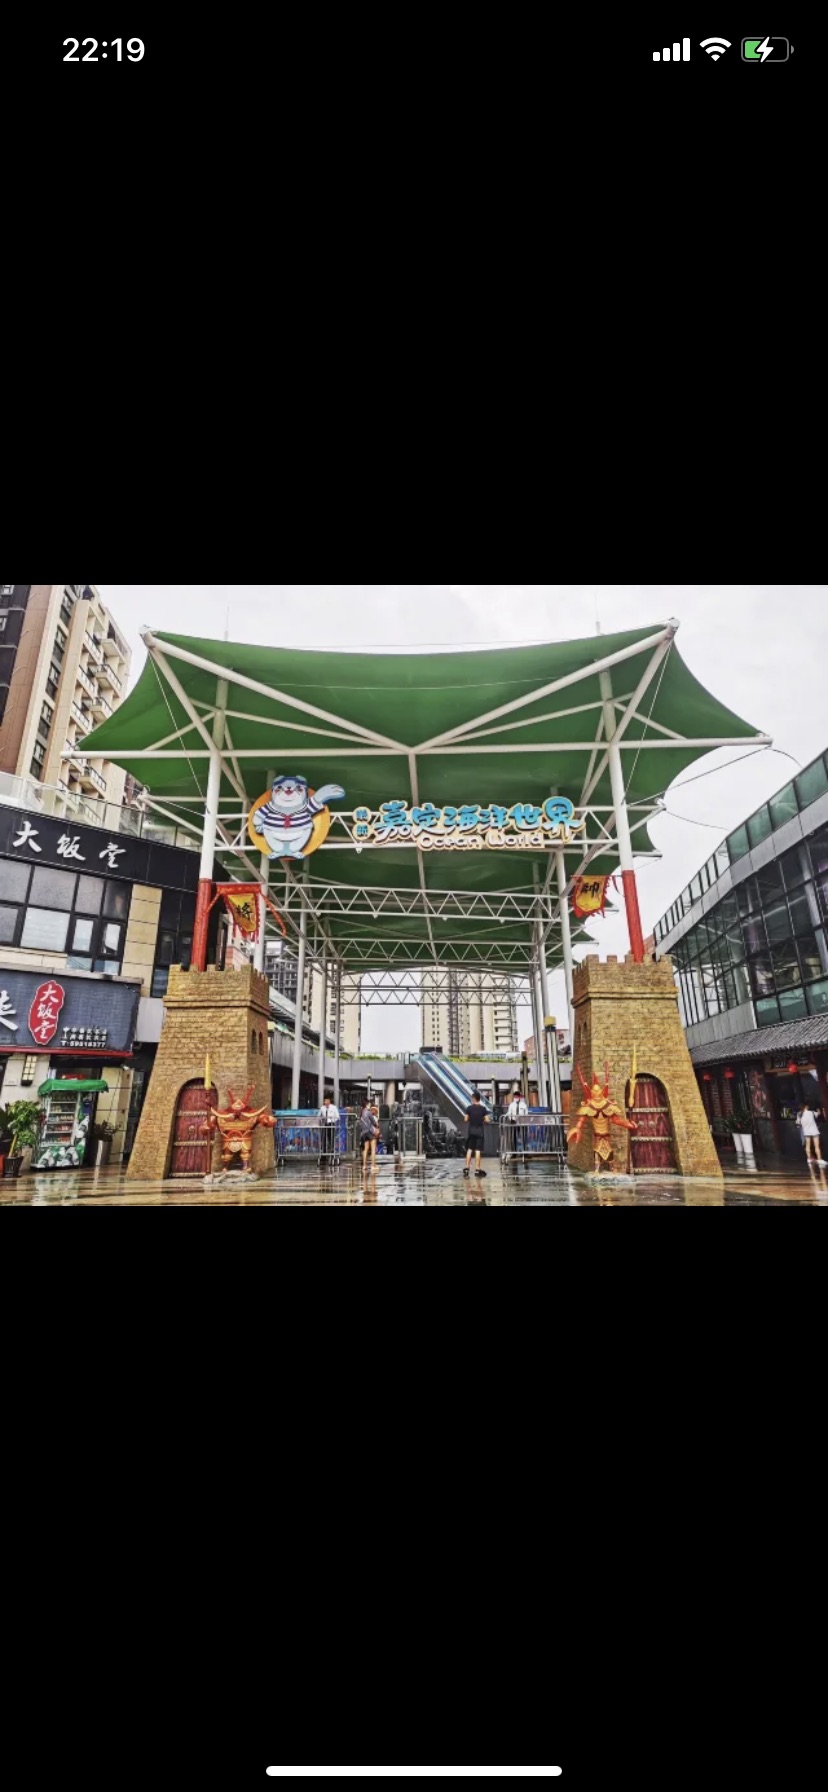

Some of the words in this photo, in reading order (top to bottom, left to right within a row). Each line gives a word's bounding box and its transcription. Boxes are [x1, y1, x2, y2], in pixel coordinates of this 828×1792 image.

[375, 797, 582, 842] 嘉定海洋世界
[422, 836, 482, 850] Ocean
[490, 834, 543, 849] World
